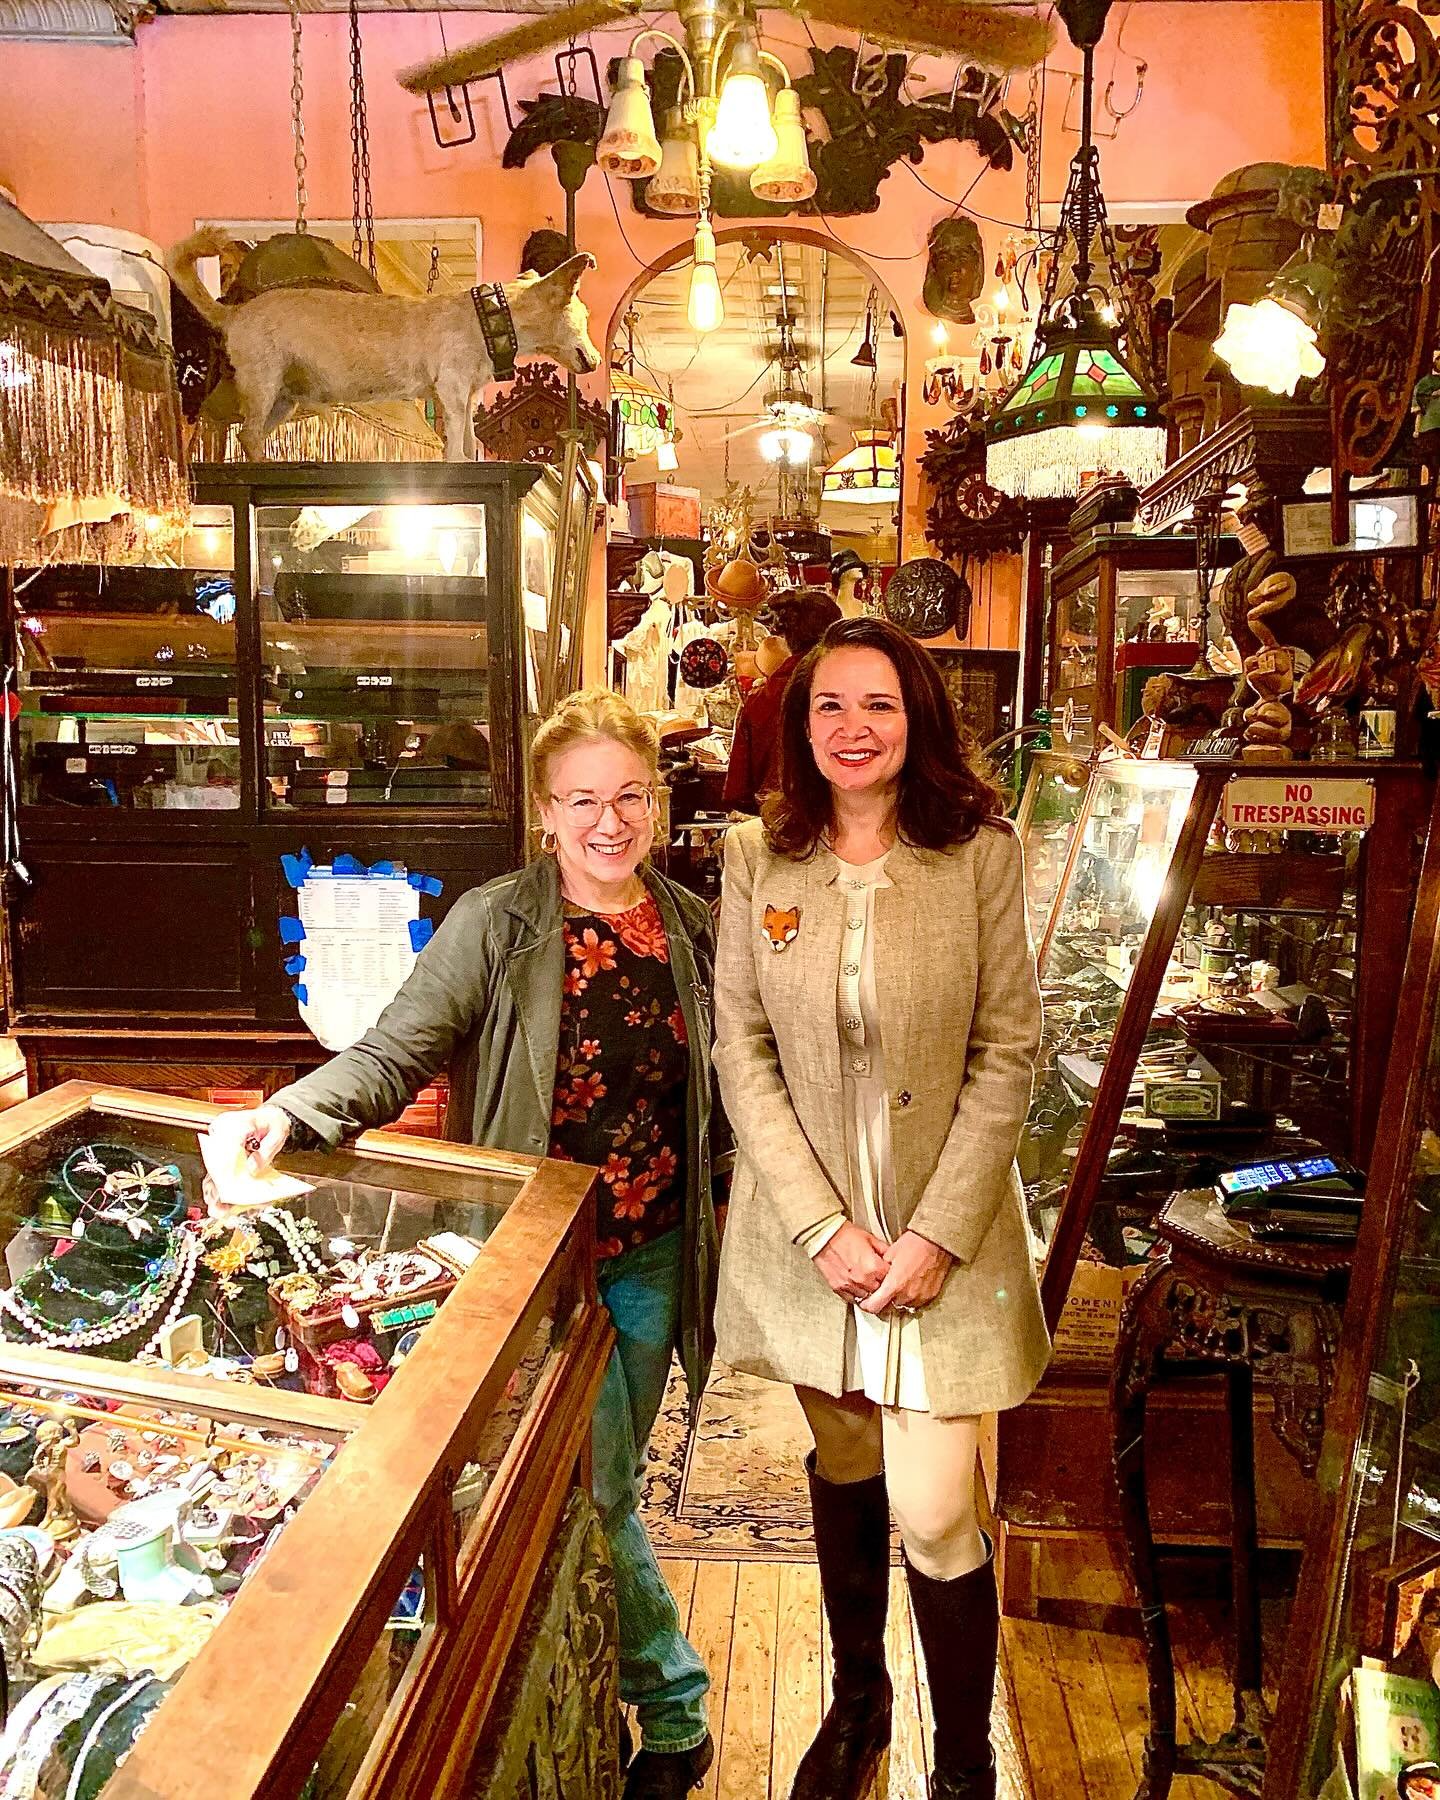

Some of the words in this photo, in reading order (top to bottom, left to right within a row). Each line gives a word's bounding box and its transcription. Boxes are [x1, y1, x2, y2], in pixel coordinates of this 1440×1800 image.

[1285, 784, 1313, 802] NO
[1232, 804, 1365, 825] TRESPASSING
[1066, 1297, 1117, 1308] OMEN!
